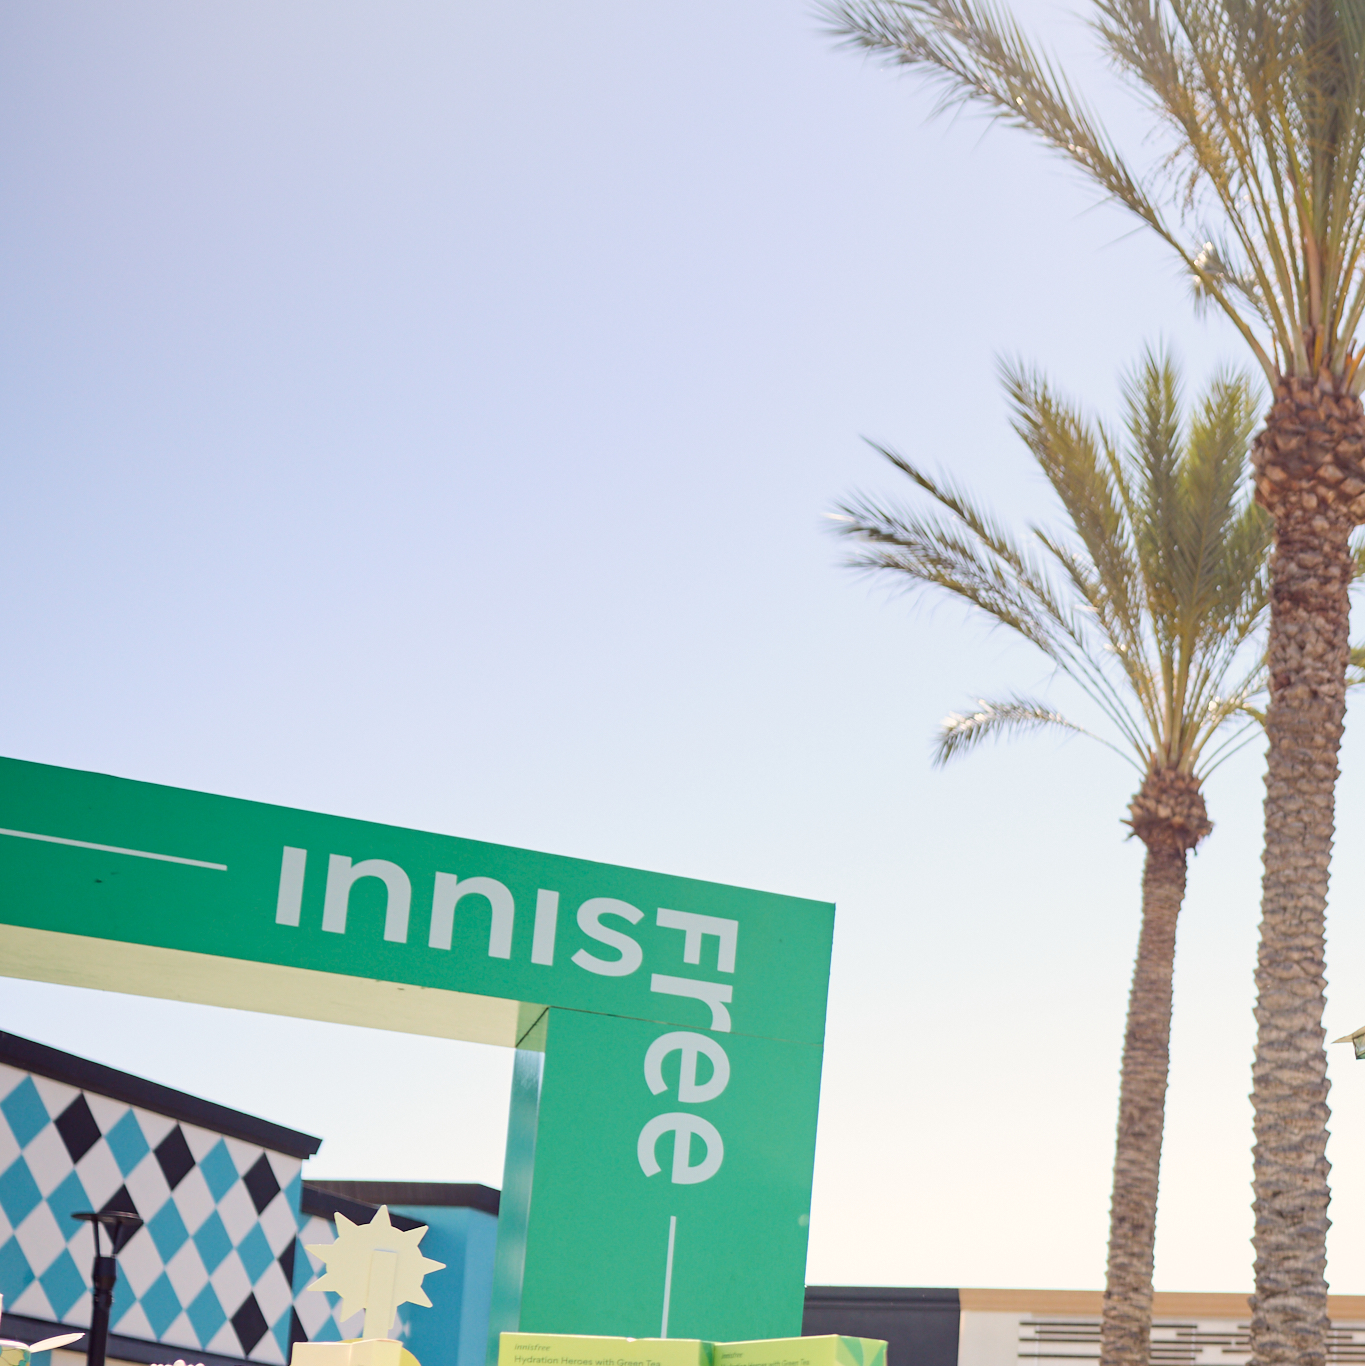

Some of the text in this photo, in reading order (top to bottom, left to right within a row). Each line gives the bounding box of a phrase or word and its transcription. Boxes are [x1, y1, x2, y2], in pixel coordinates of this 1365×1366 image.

[514, 1344, 551, 1352] innisfree
[514, 1356, 558, 1365] Hydration
[560, 1357, 593, 1366] Heroes
[595, 1358, 615, 1366] with
